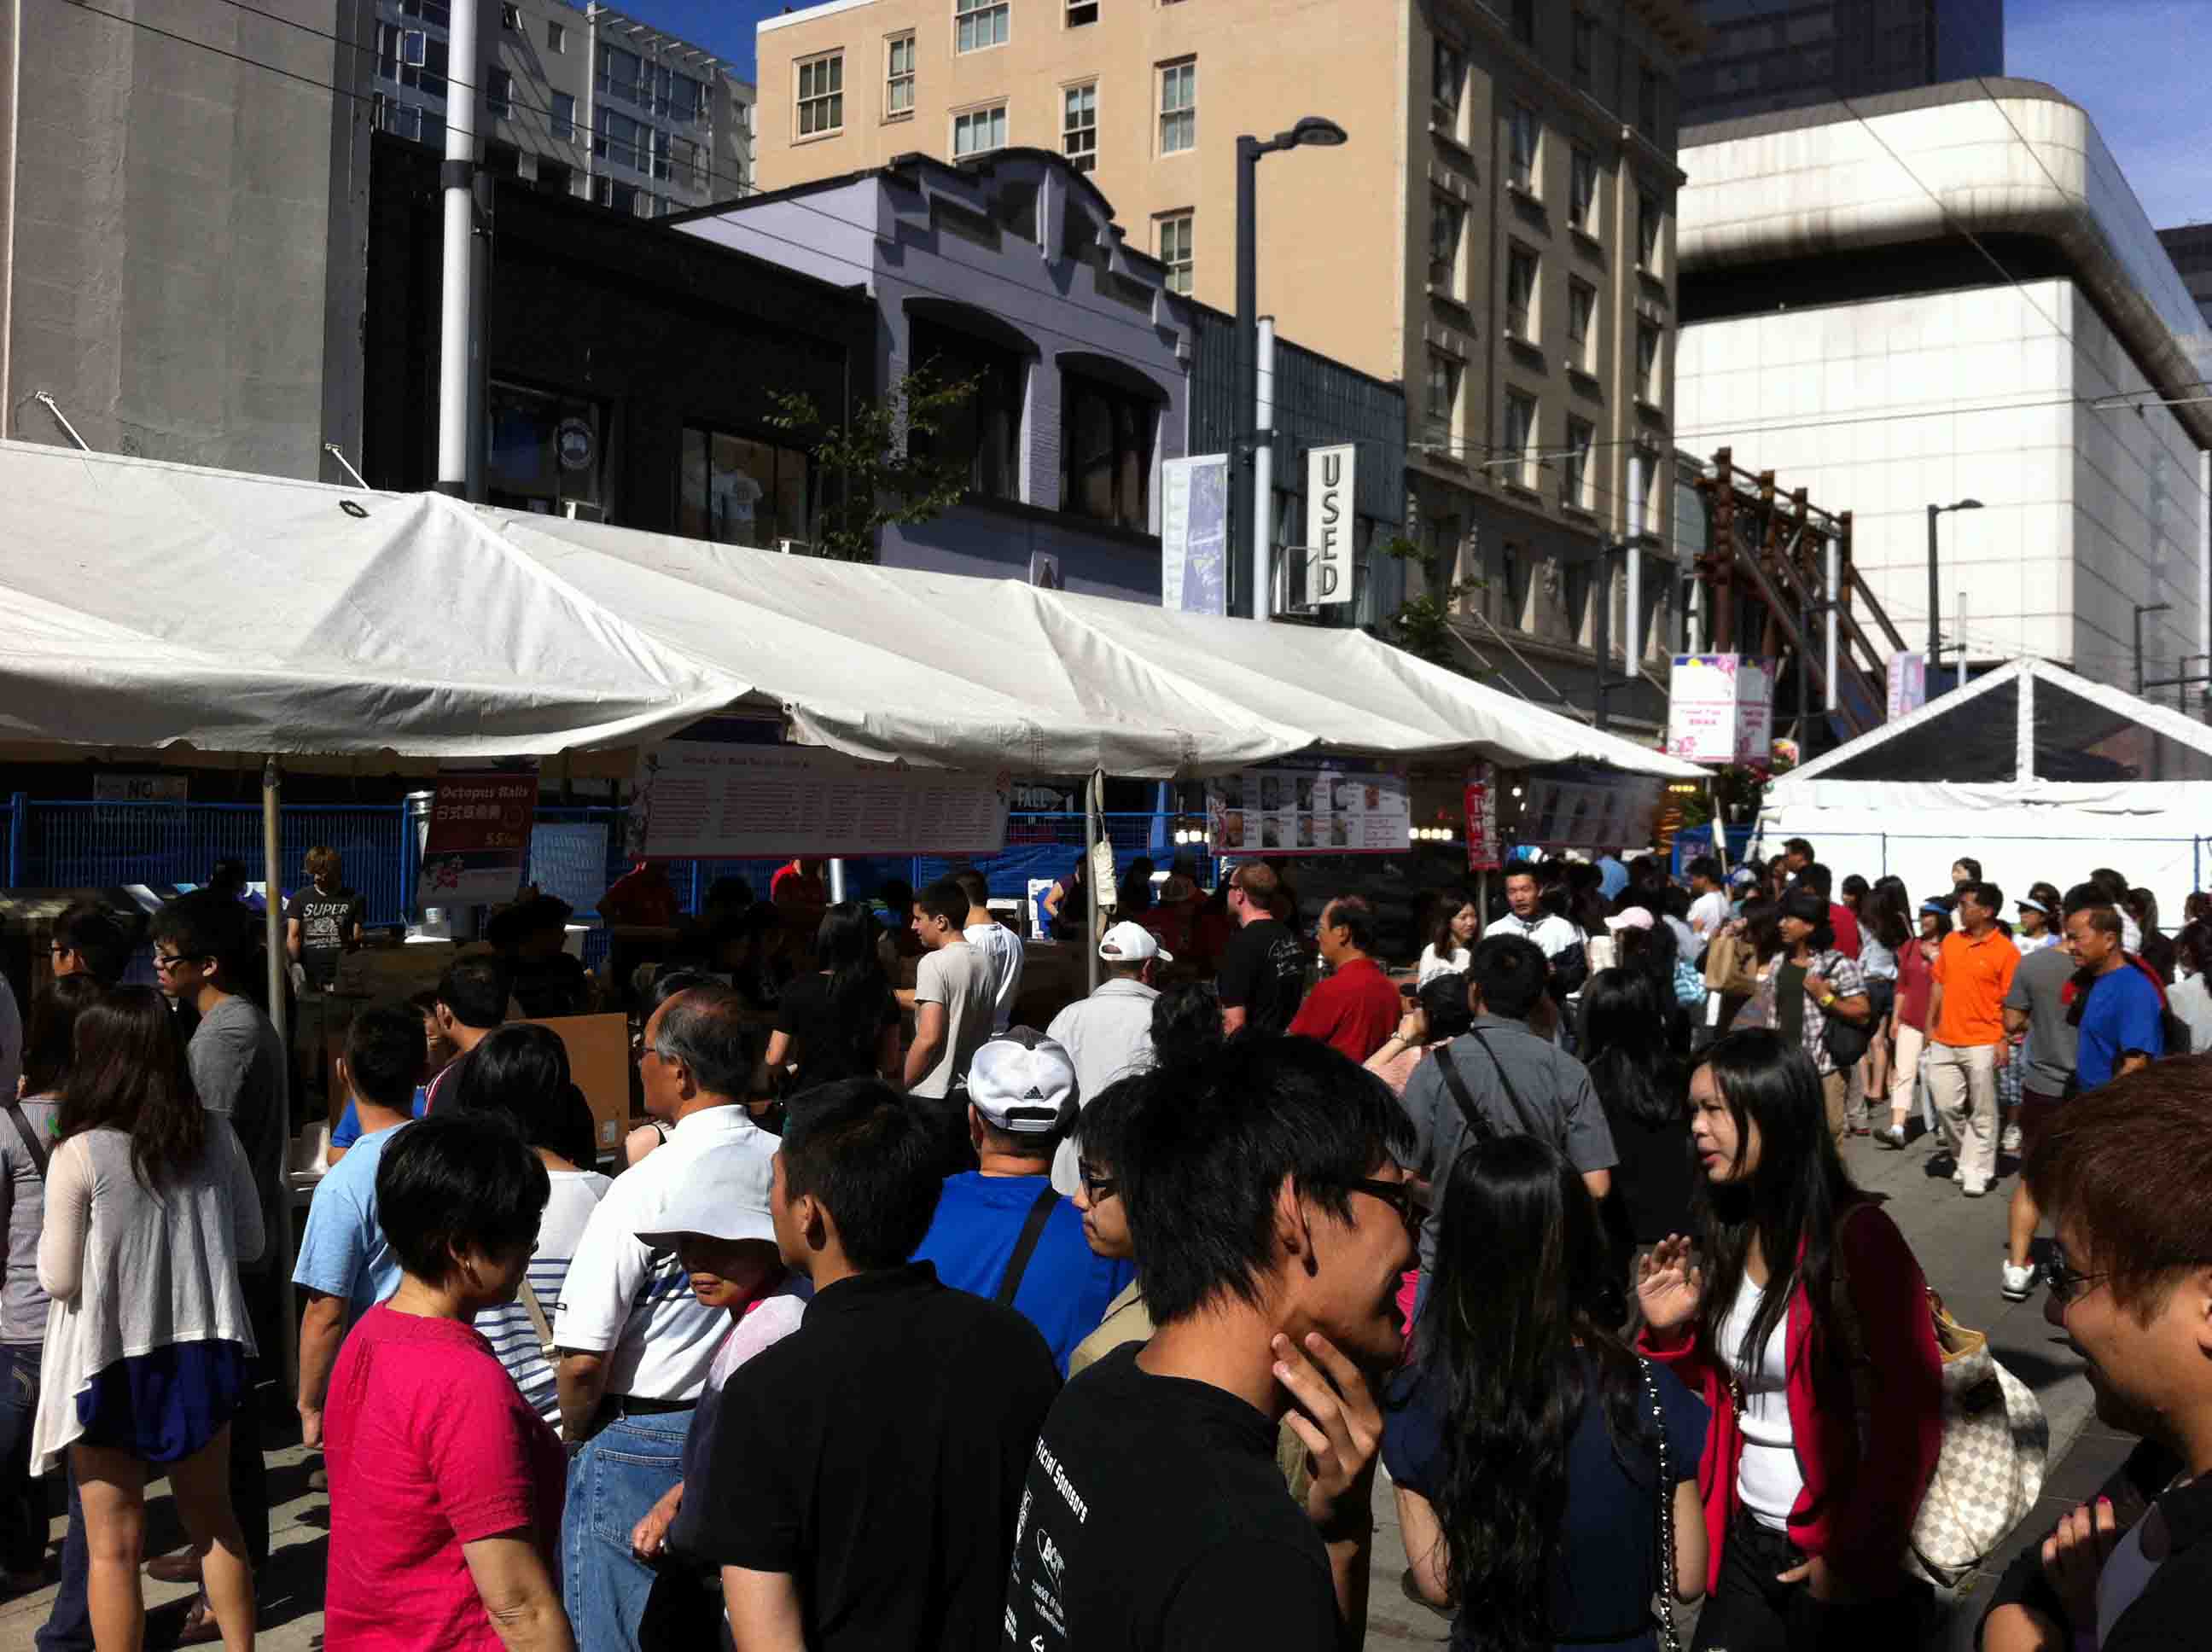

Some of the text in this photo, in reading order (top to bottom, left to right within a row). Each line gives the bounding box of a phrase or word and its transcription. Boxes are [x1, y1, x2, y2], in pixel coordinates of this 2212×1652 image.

[1318, 453, 1341, 596] USED
[303, 903, 349, 916] SUPER
[1053, 1463, 1088, 1523] Sponsors
